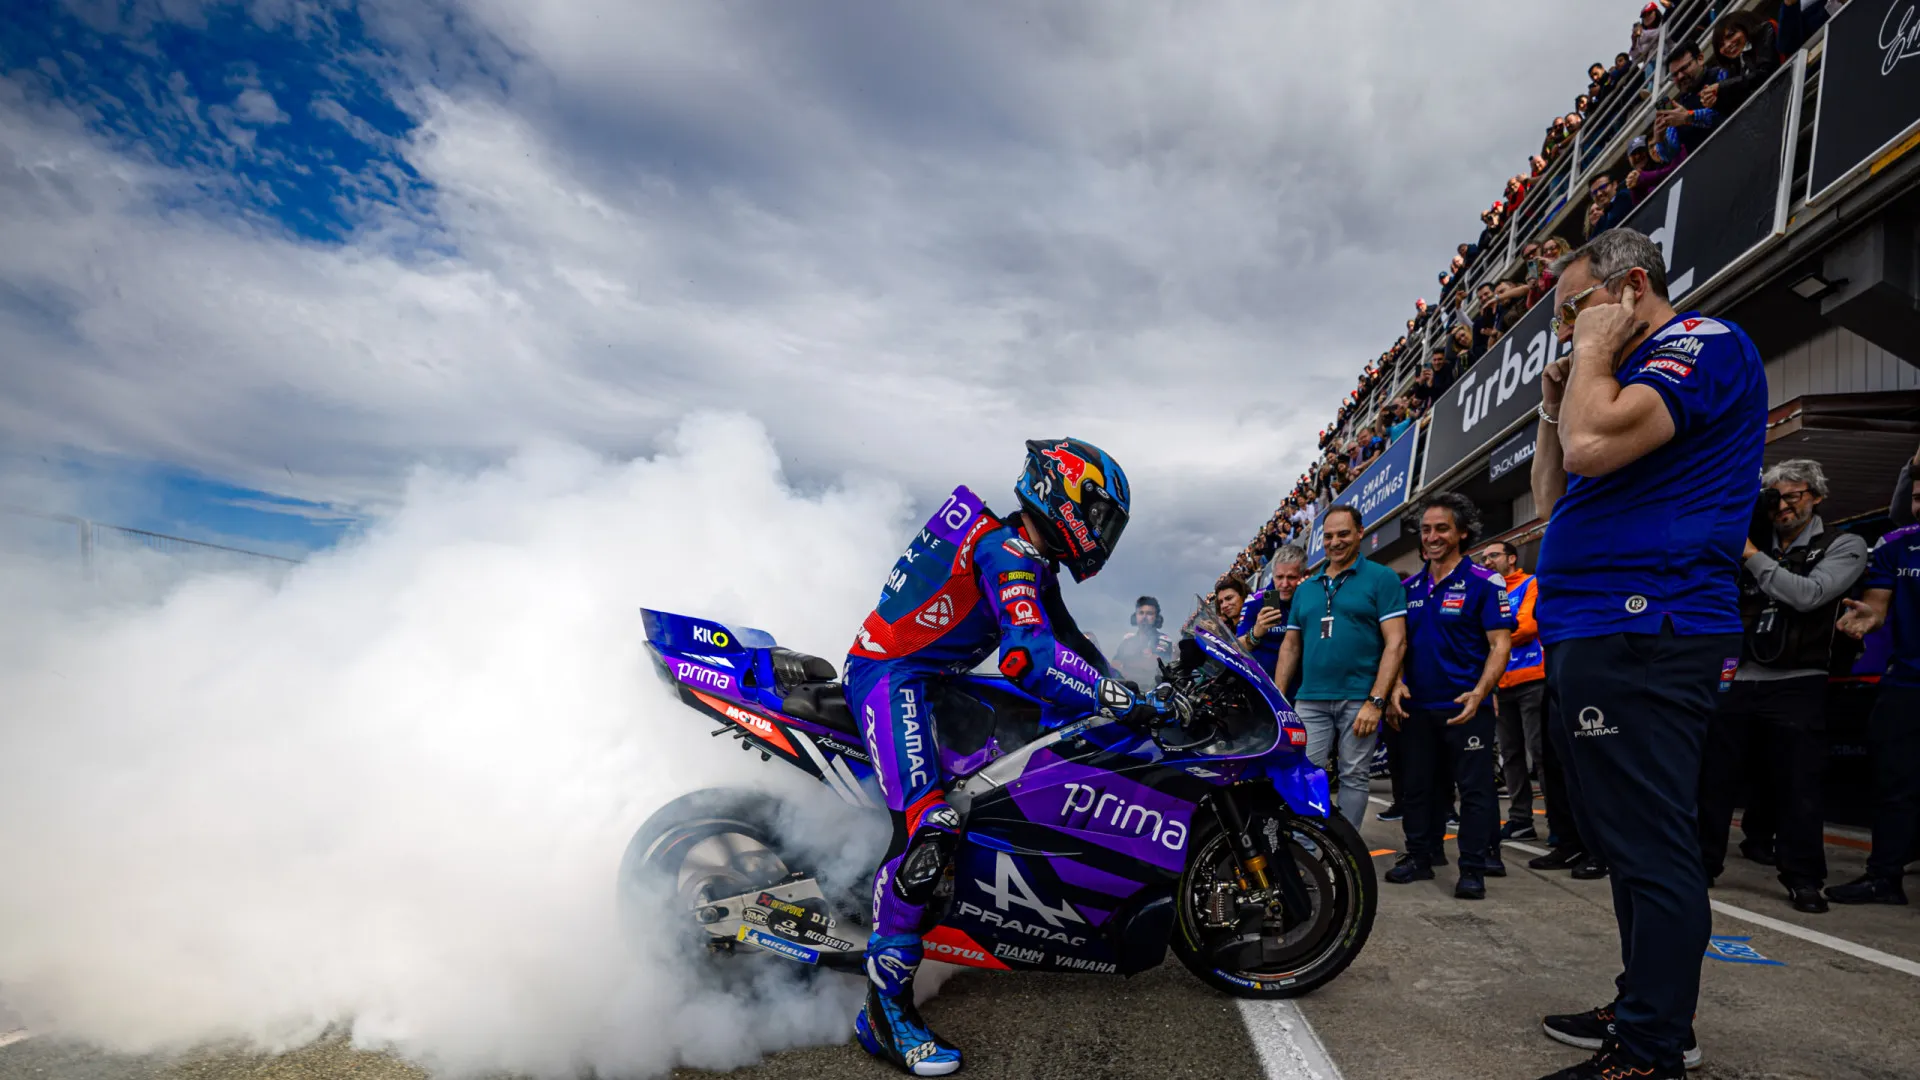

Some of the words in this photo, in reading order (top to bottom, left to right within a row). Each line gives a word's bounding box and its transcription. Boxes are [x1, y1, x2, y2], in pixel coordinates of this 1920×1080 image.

[1513, 440, 1537, 464] MILL
[1360, 471, 1405, 516] COATINGS
[1362, 464, 1392, 500] SMART
[1058, 500, 1085, 531] Red
[1073, 525, 1097, 553] Bull
[1001, 585, 1036, 601] MOTUL
[693, 625, 729, 648] KILO
[677, 662, 730, 690] prima
[1060, 650, 1099, 680] prim
[725, 705, 774, 733] MOTUL
[899, 688, 928, 788] PRAMAC
[1574, 726, 1620, 739] PRAMAC
[1060, 782, 1188, 851] prima
[958, 902, 1087, 947] PRAMAC
[761, 938, 811, 960] MICHELIN
[804, 929, 852, 952] ACCOSSATO
[922, 939, 986, 962] MOTUL
[994, 942, 1046, 964] FIAMM
[1055, 954, 1118, 975] YAMAHA
